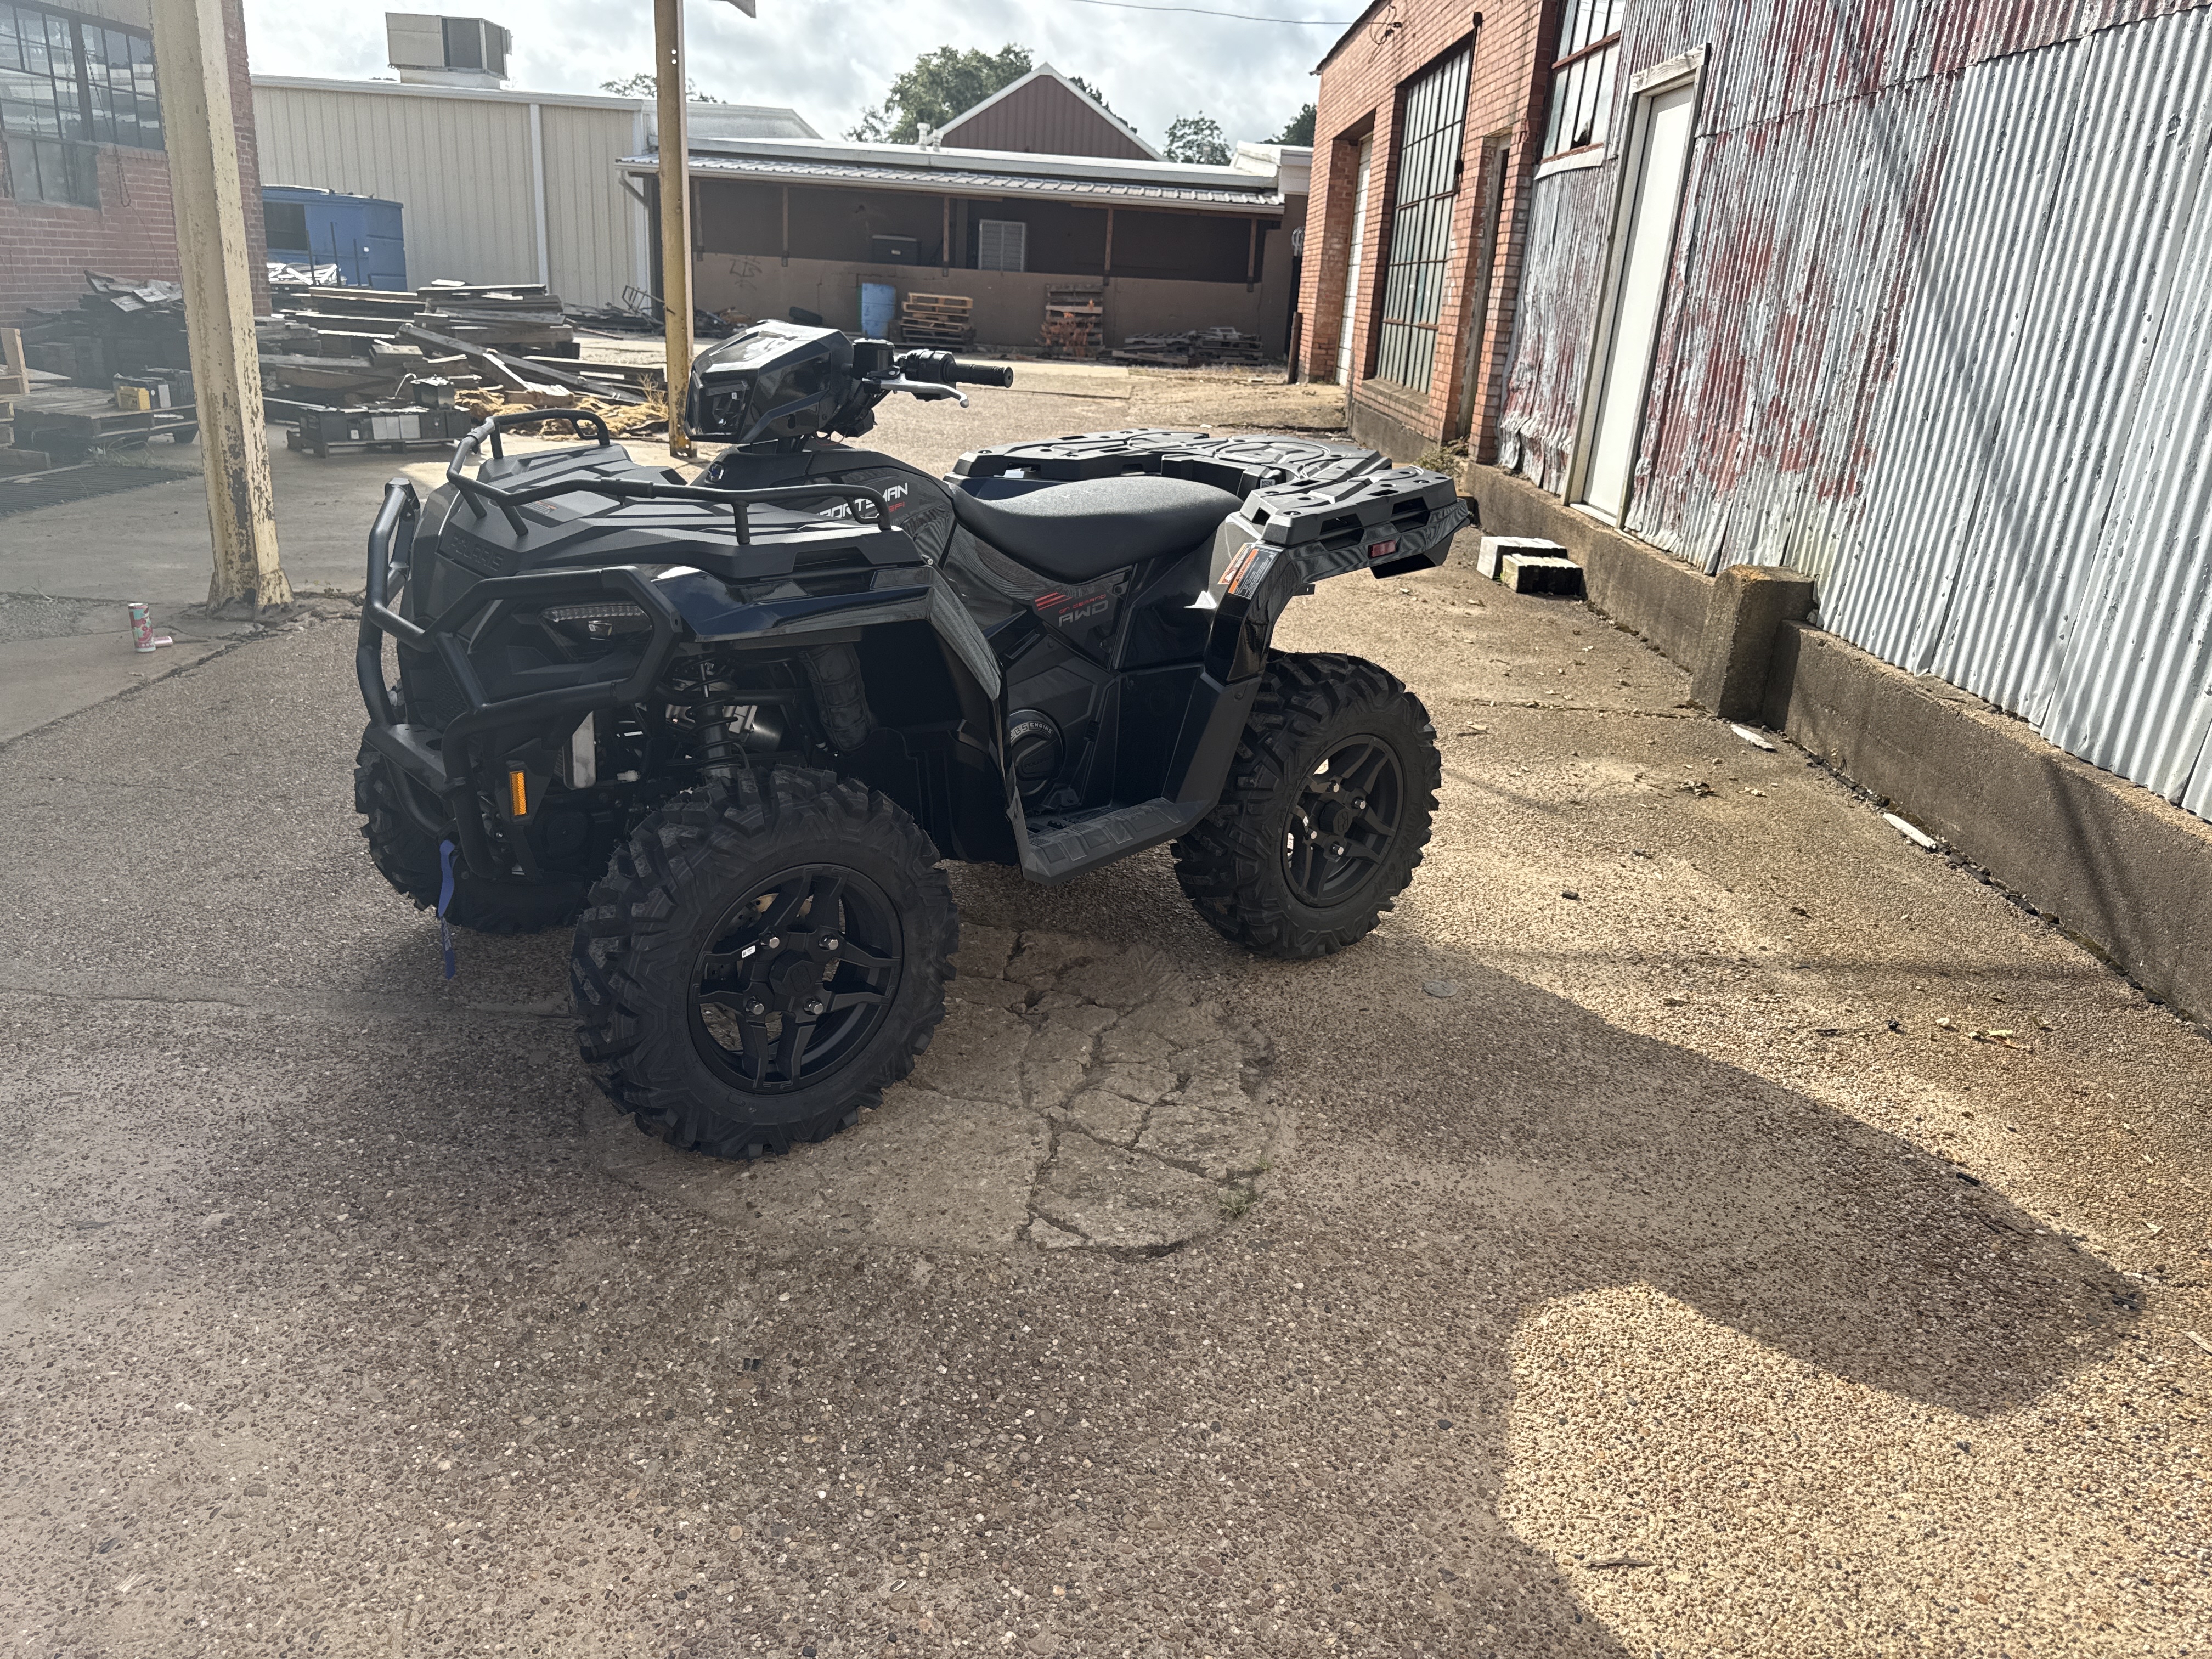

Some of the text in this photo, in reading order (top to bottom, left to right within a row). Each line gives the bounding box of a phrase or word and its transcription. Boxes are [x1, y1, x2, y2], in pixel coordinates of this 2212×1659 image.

[816, 482, 909, 518] PORTSAN
[447, 537, 505, 572] POLARIS
[1058, 600, 1109, 628] AWD
[1030, 721, 1053, 735] ENGINE
